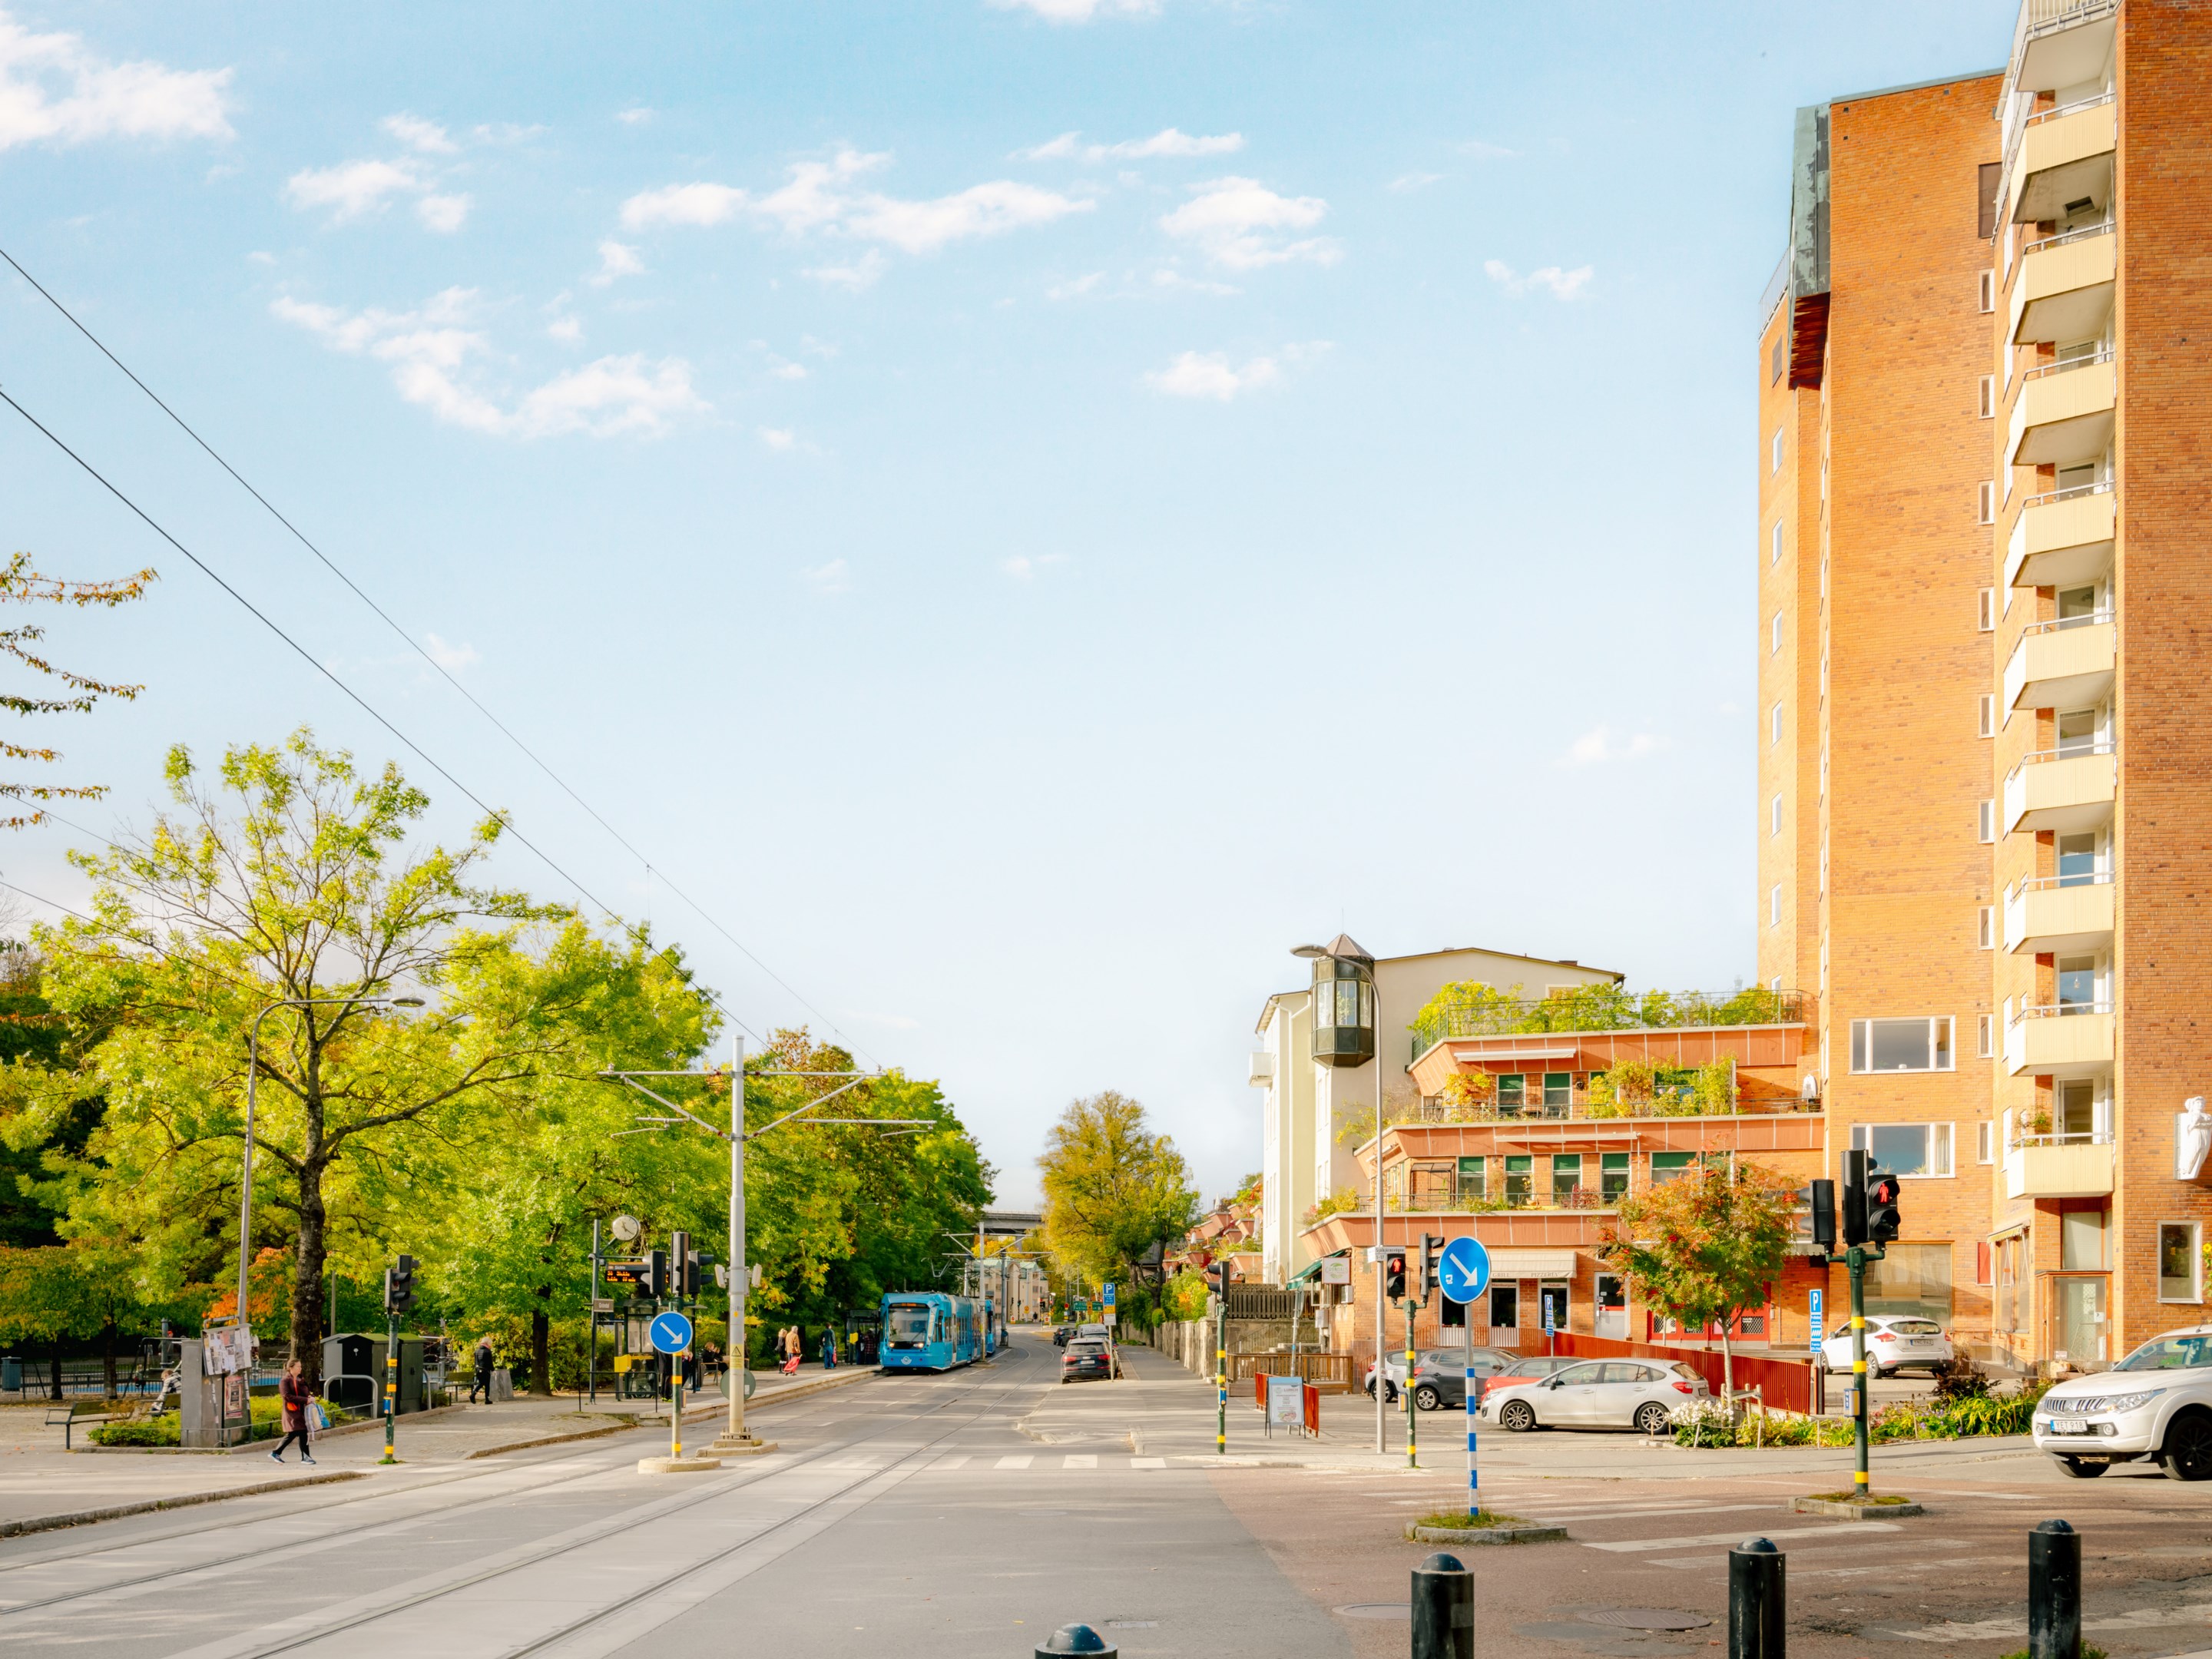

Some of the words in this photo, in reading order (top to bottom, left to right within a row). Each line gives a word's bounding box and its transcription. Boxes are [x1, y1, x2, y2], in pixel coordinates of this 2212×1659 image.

[1106, 1284, 1112, 1293] P
[1813, 1292, 1819, 1311] P
[2056, 1421, 2068, 1429] YET
[2070, 1421, 2084, 1429] 918
